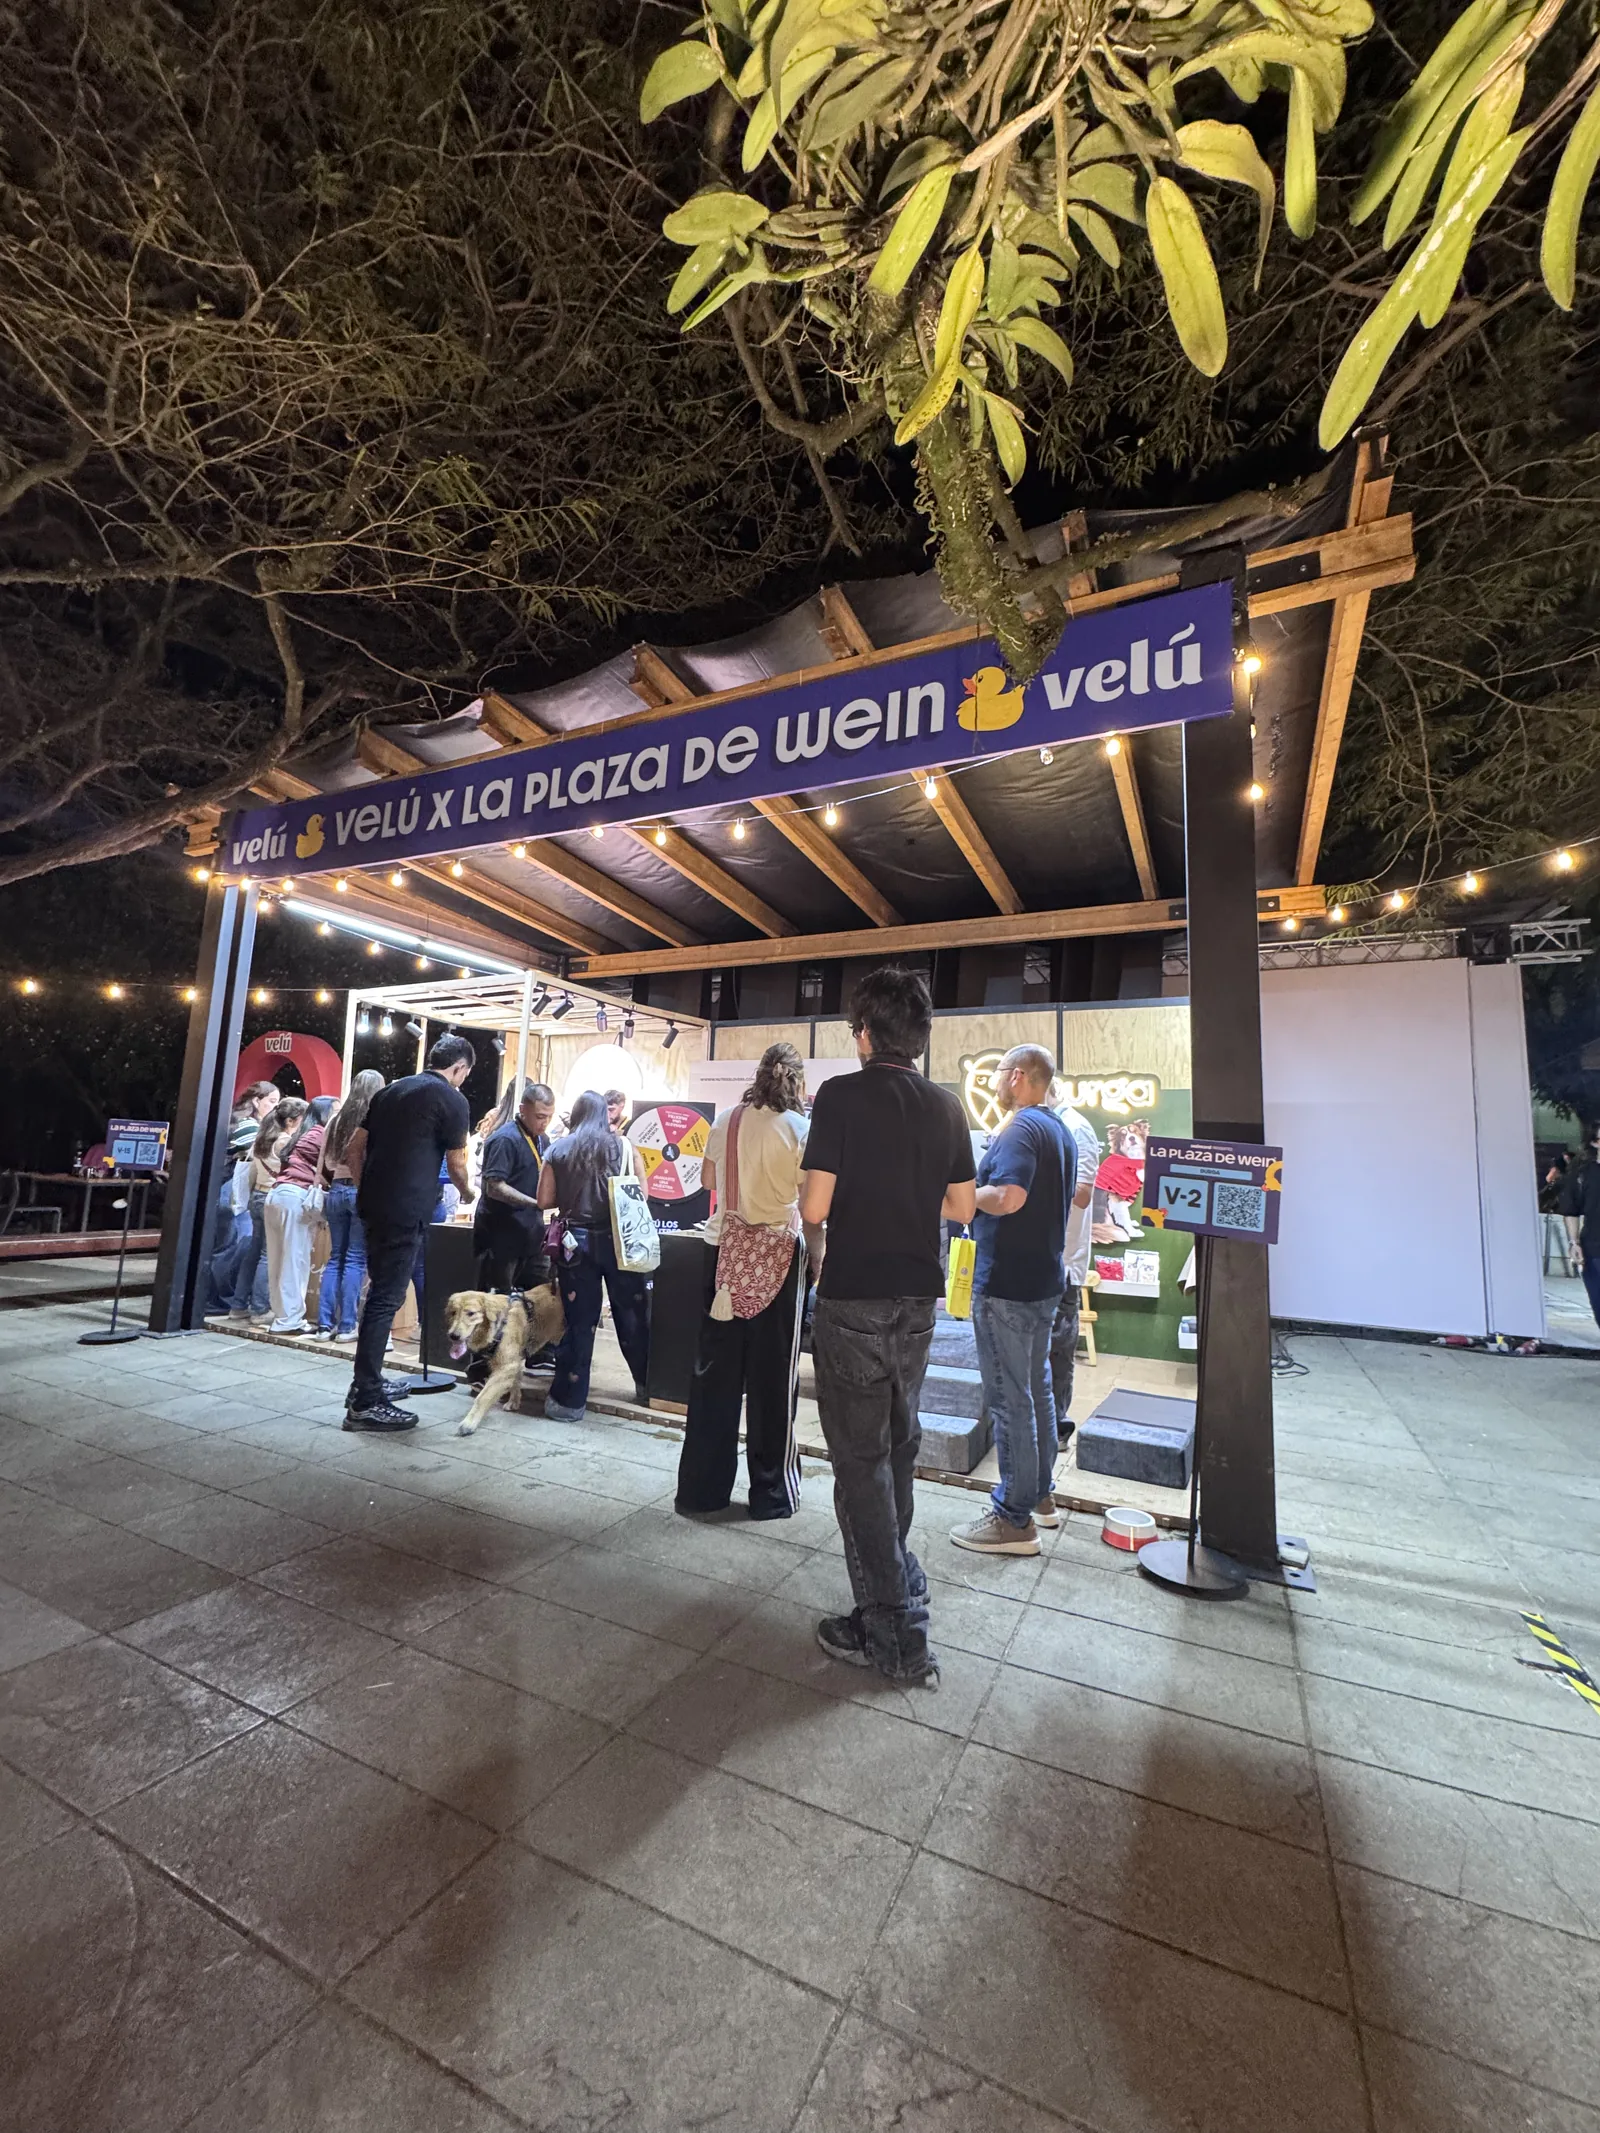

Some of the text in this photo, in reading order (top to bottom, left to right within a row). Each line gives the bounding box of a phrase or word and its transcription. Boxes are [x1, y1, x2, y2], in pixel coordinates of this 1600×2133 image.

[1042, 622, 1203, 710] velú
[426, 790, 454, 831] X
[232, 821, 288, 865] velú
[265, 1032, 292, 1052] velú
[1056, 1077, 1156, 1115] urga
[1164, 1185, 1202, 1208] V-2
[662, 1220, 678, 1228] LOS
